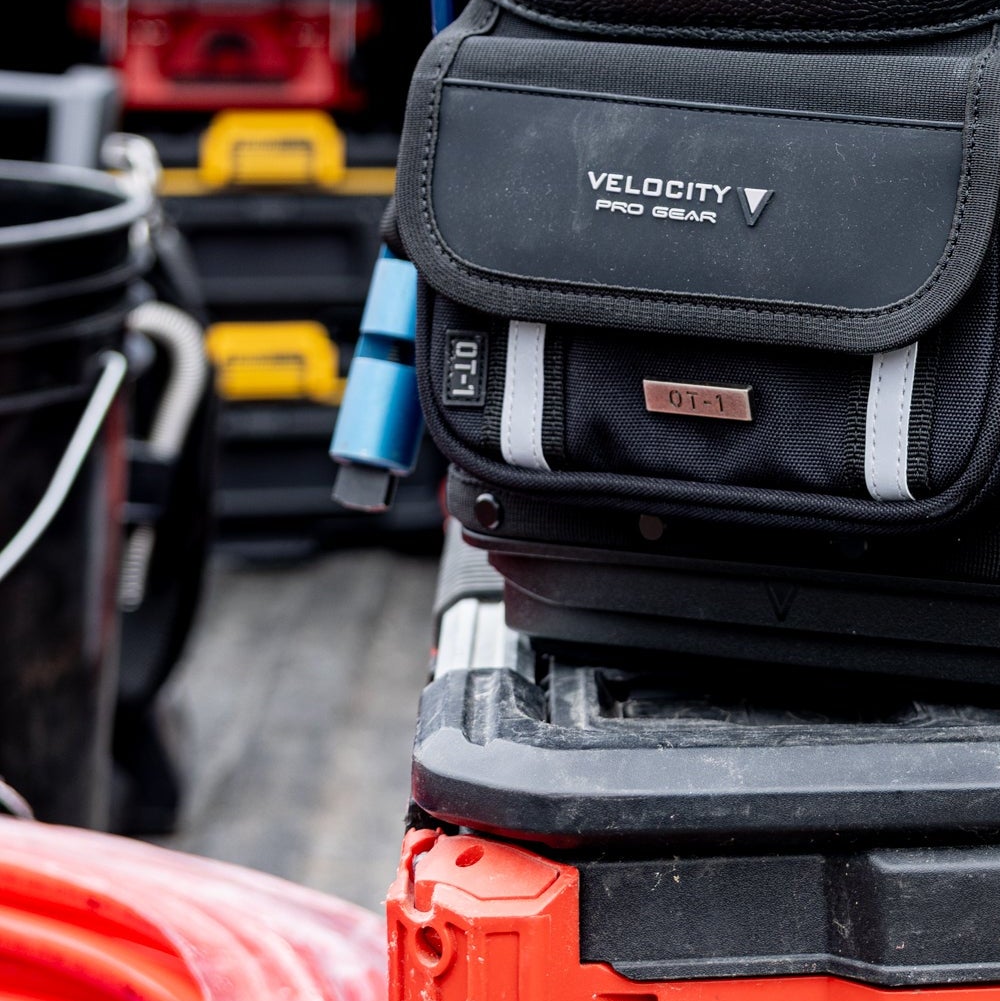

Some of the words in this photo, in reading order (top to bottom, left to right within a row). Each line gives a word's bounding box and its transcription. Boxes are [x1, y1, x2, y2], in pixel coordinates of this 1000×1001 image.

[587, 170, 732, 203] VELOCITY
[595, 198, 645, 215] PRO
[652, 205, 717, 224] GEAR
[452, 341, 478, 396] OT-1
[668, 389, 724, 412] OT-1
